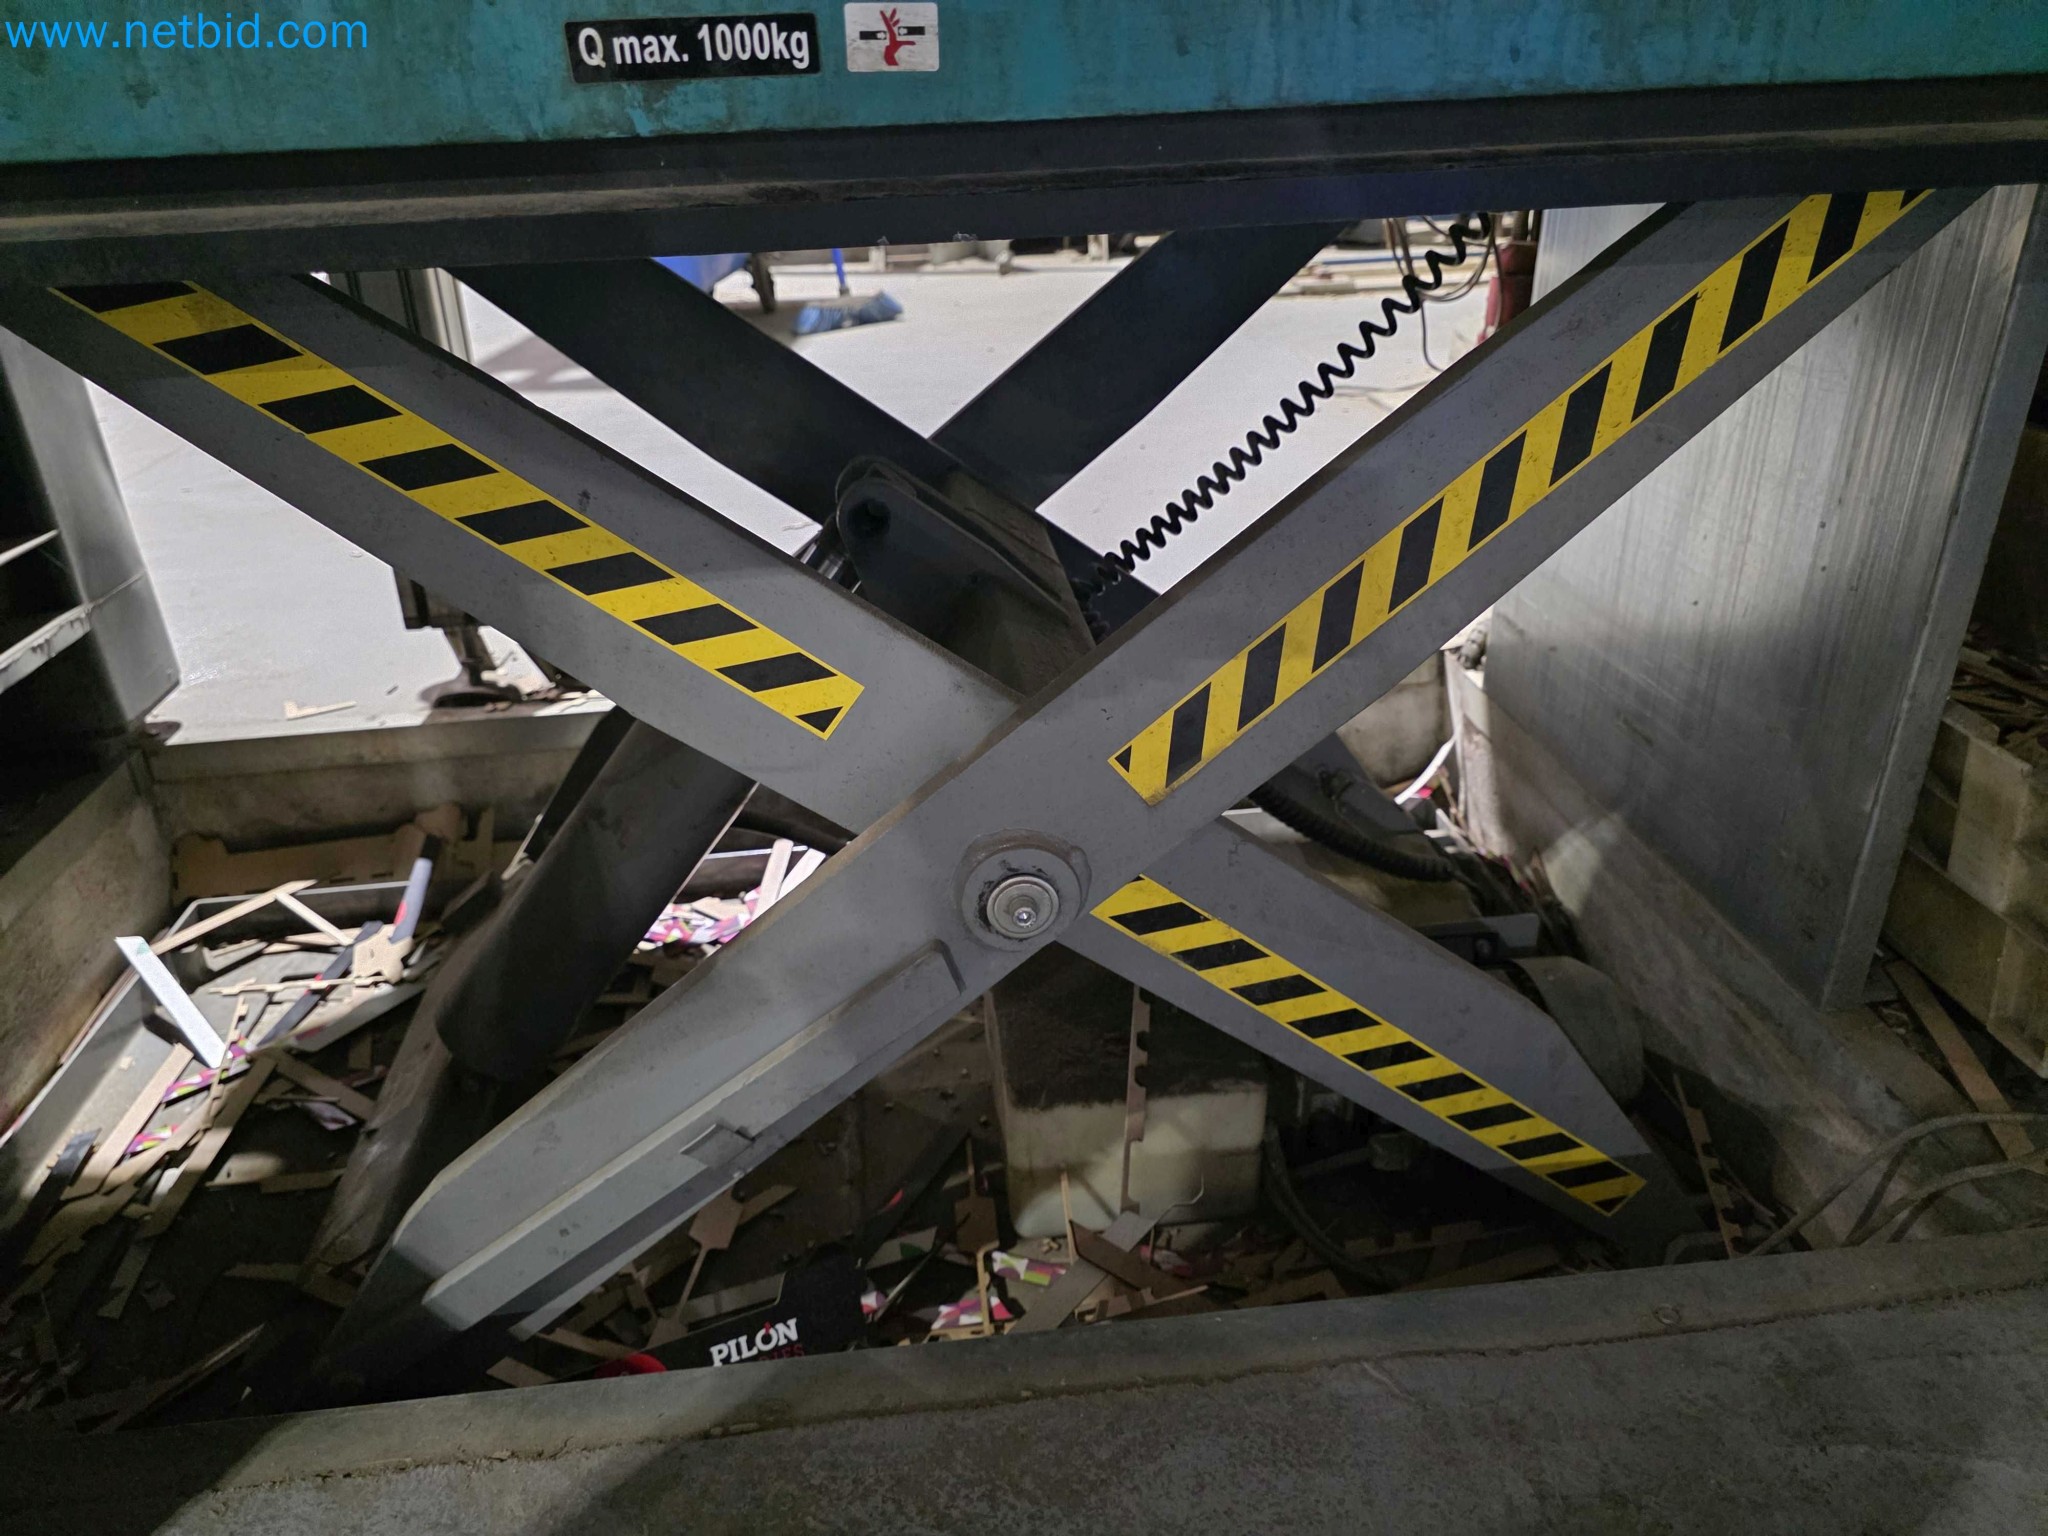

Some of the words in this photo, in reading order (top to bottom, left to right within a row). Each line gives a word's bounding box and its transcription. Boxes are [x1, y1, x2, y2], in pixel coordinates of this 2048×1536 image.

[578, 27, 606, 69] Q
[612, 32, 689, 65] max.
[697, 22, 810, 69] 1000kg
